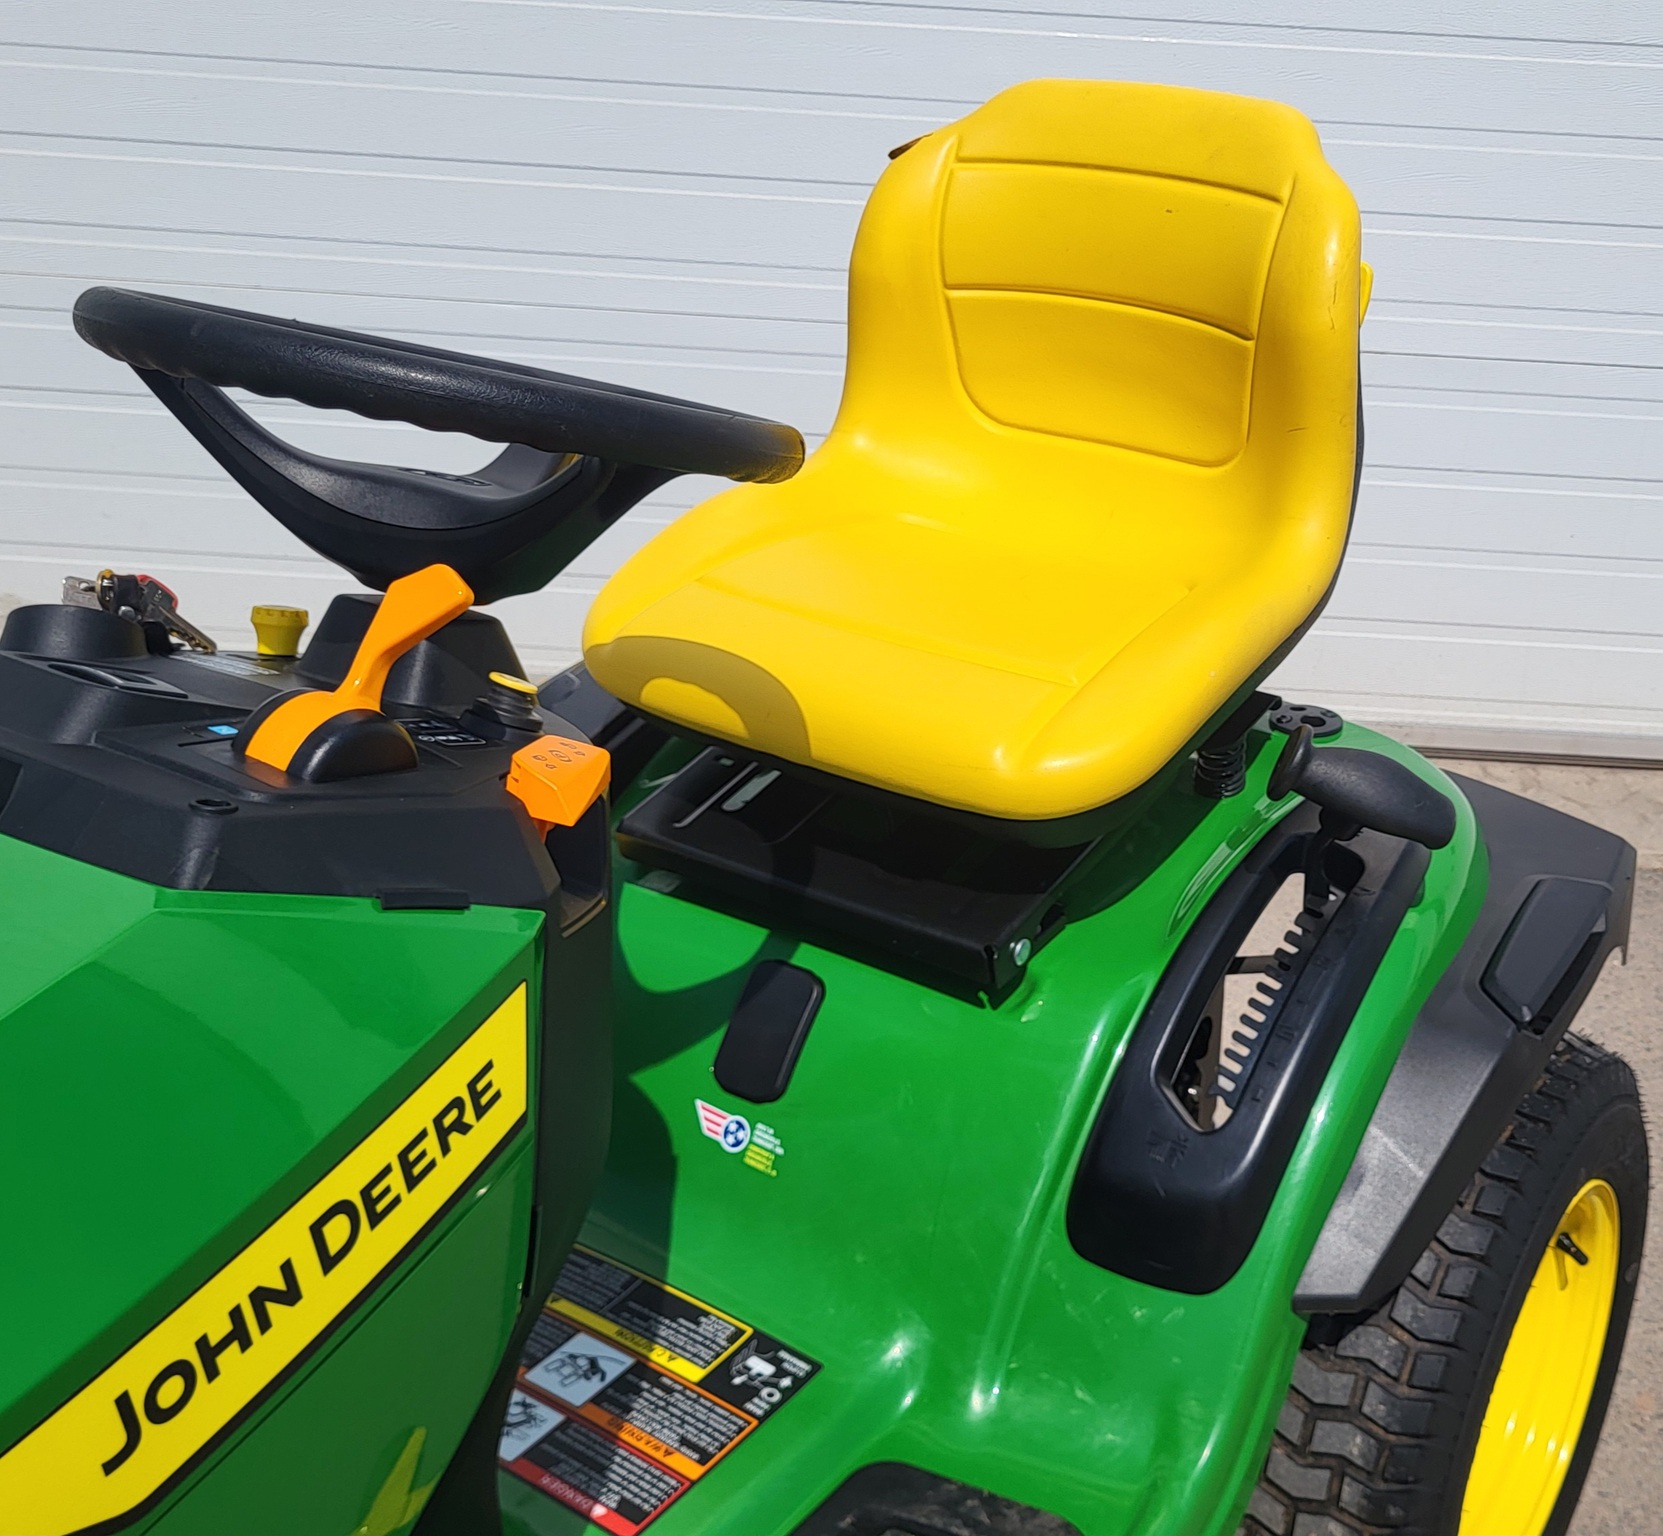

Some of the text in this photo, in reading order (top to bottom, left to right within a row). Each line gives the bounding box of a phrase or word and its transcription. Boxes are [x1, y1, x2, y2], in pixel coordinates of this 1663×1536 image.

[101, 1058, 502, 1477] JOHN DEERE
[540, 1474, 592, 1511] DANGER
